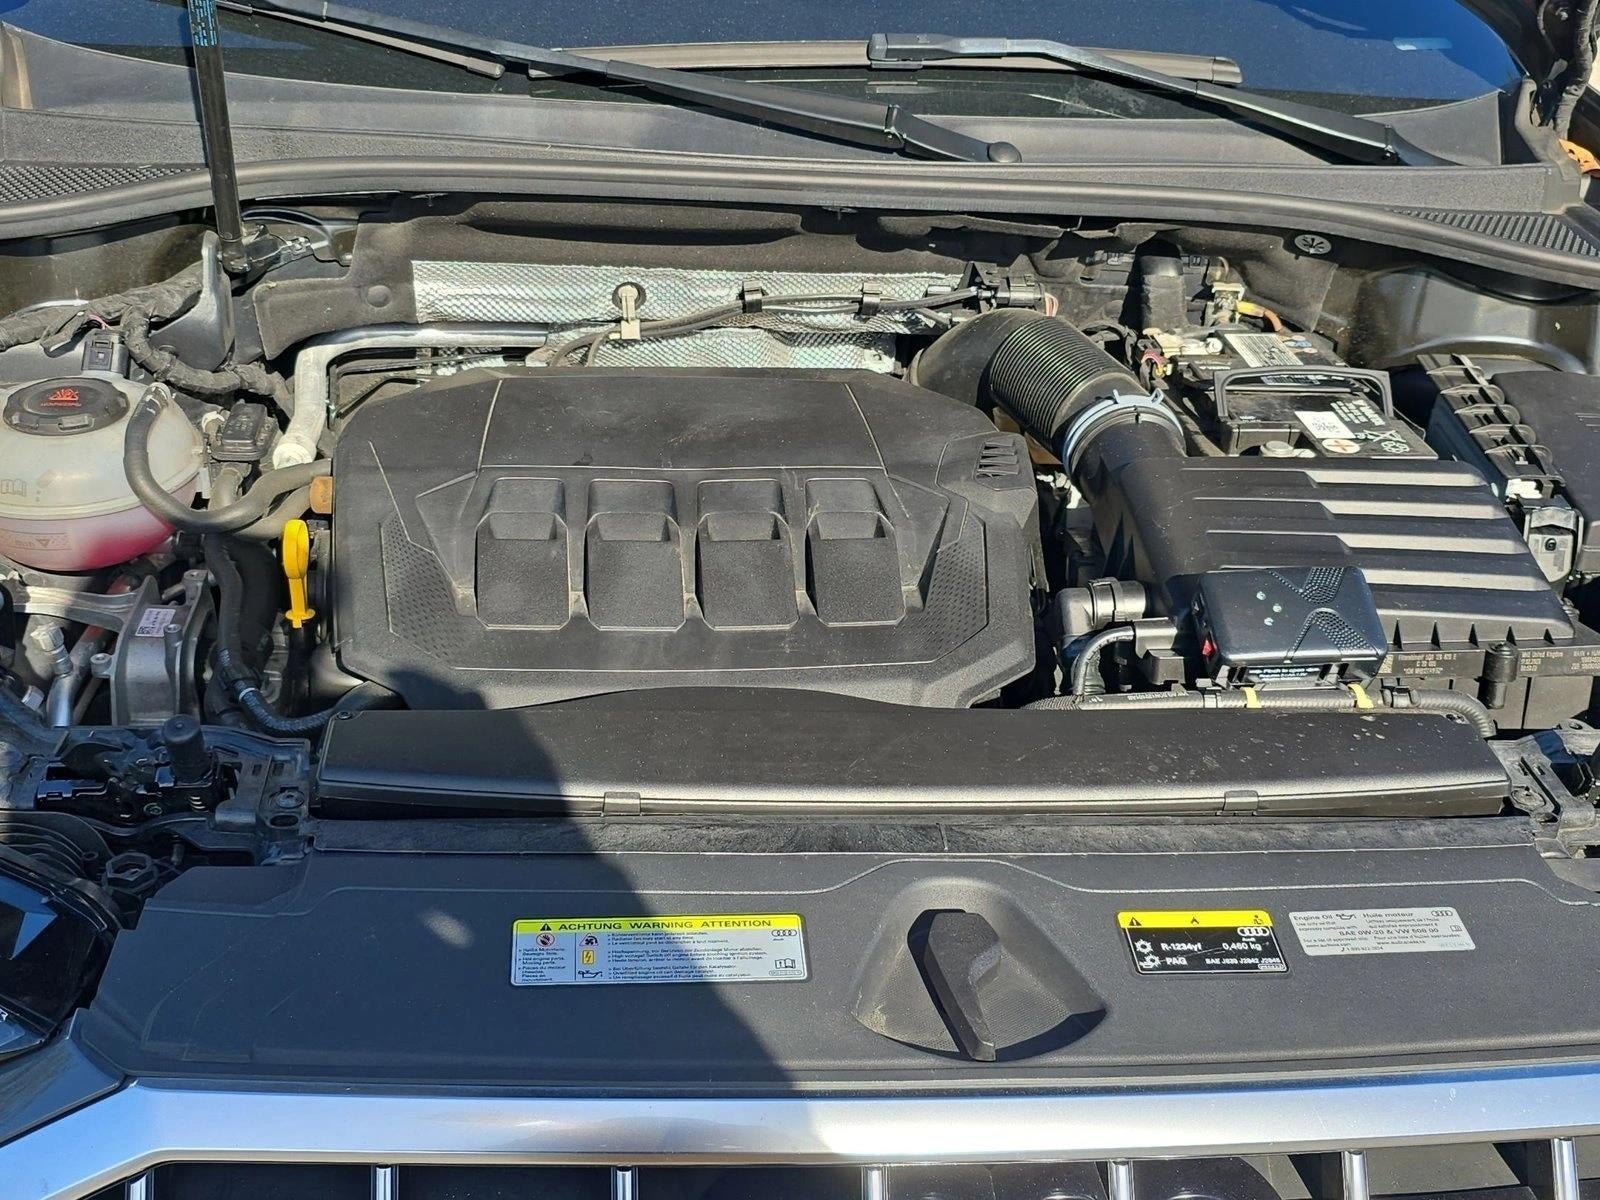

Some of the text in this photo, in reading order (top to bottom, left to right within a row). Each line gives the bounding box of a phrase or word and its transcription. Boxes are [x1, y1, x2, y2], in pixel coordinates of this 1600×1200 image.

[559, 919, 771, 931] ACHTUNG WARNING ATTENTION
[1161, 942, 1202, 952] R-1234yf
[1249, 941, 1262, 951] kg
[1166, 957, 1188, 965] PAG
